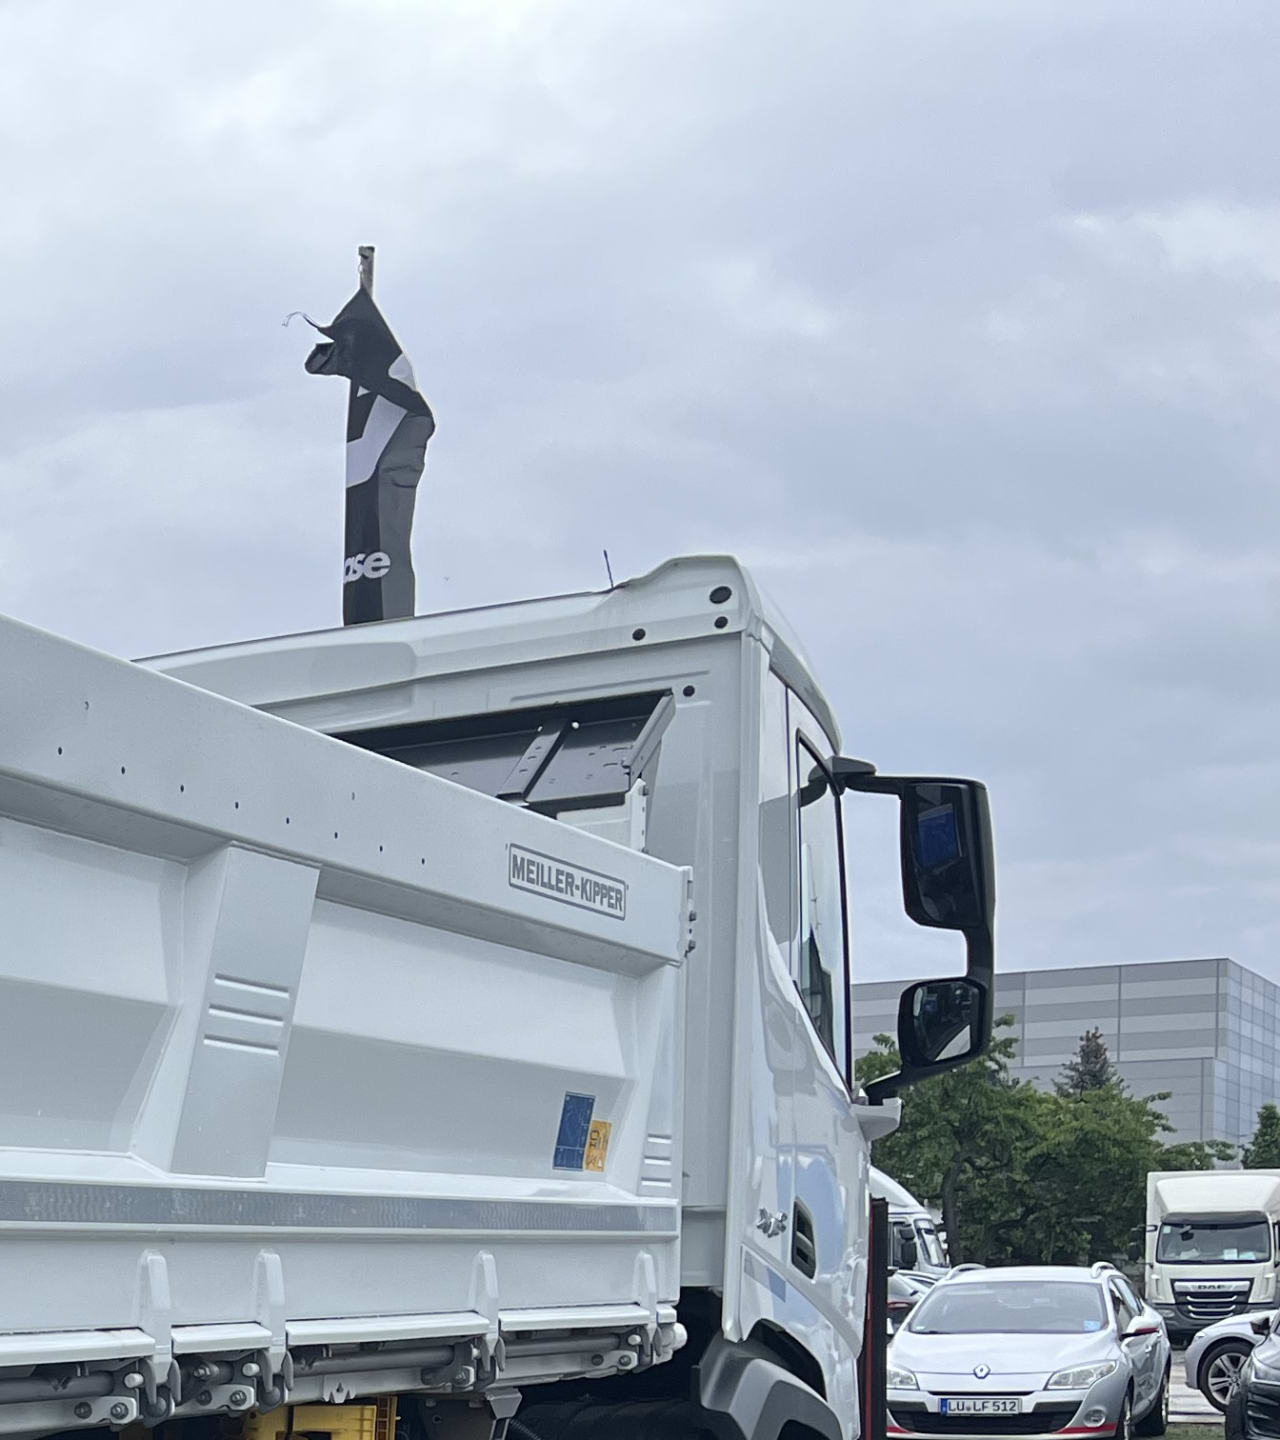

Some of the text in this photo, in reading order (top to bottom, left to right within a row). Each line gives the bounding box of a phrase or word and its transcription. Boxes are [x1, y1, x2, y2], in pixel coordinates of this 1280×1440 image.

[511, 854, 623, 912] MEILLER-KIPPER
[948, 1401, 1016, 1412] LU LF 512
